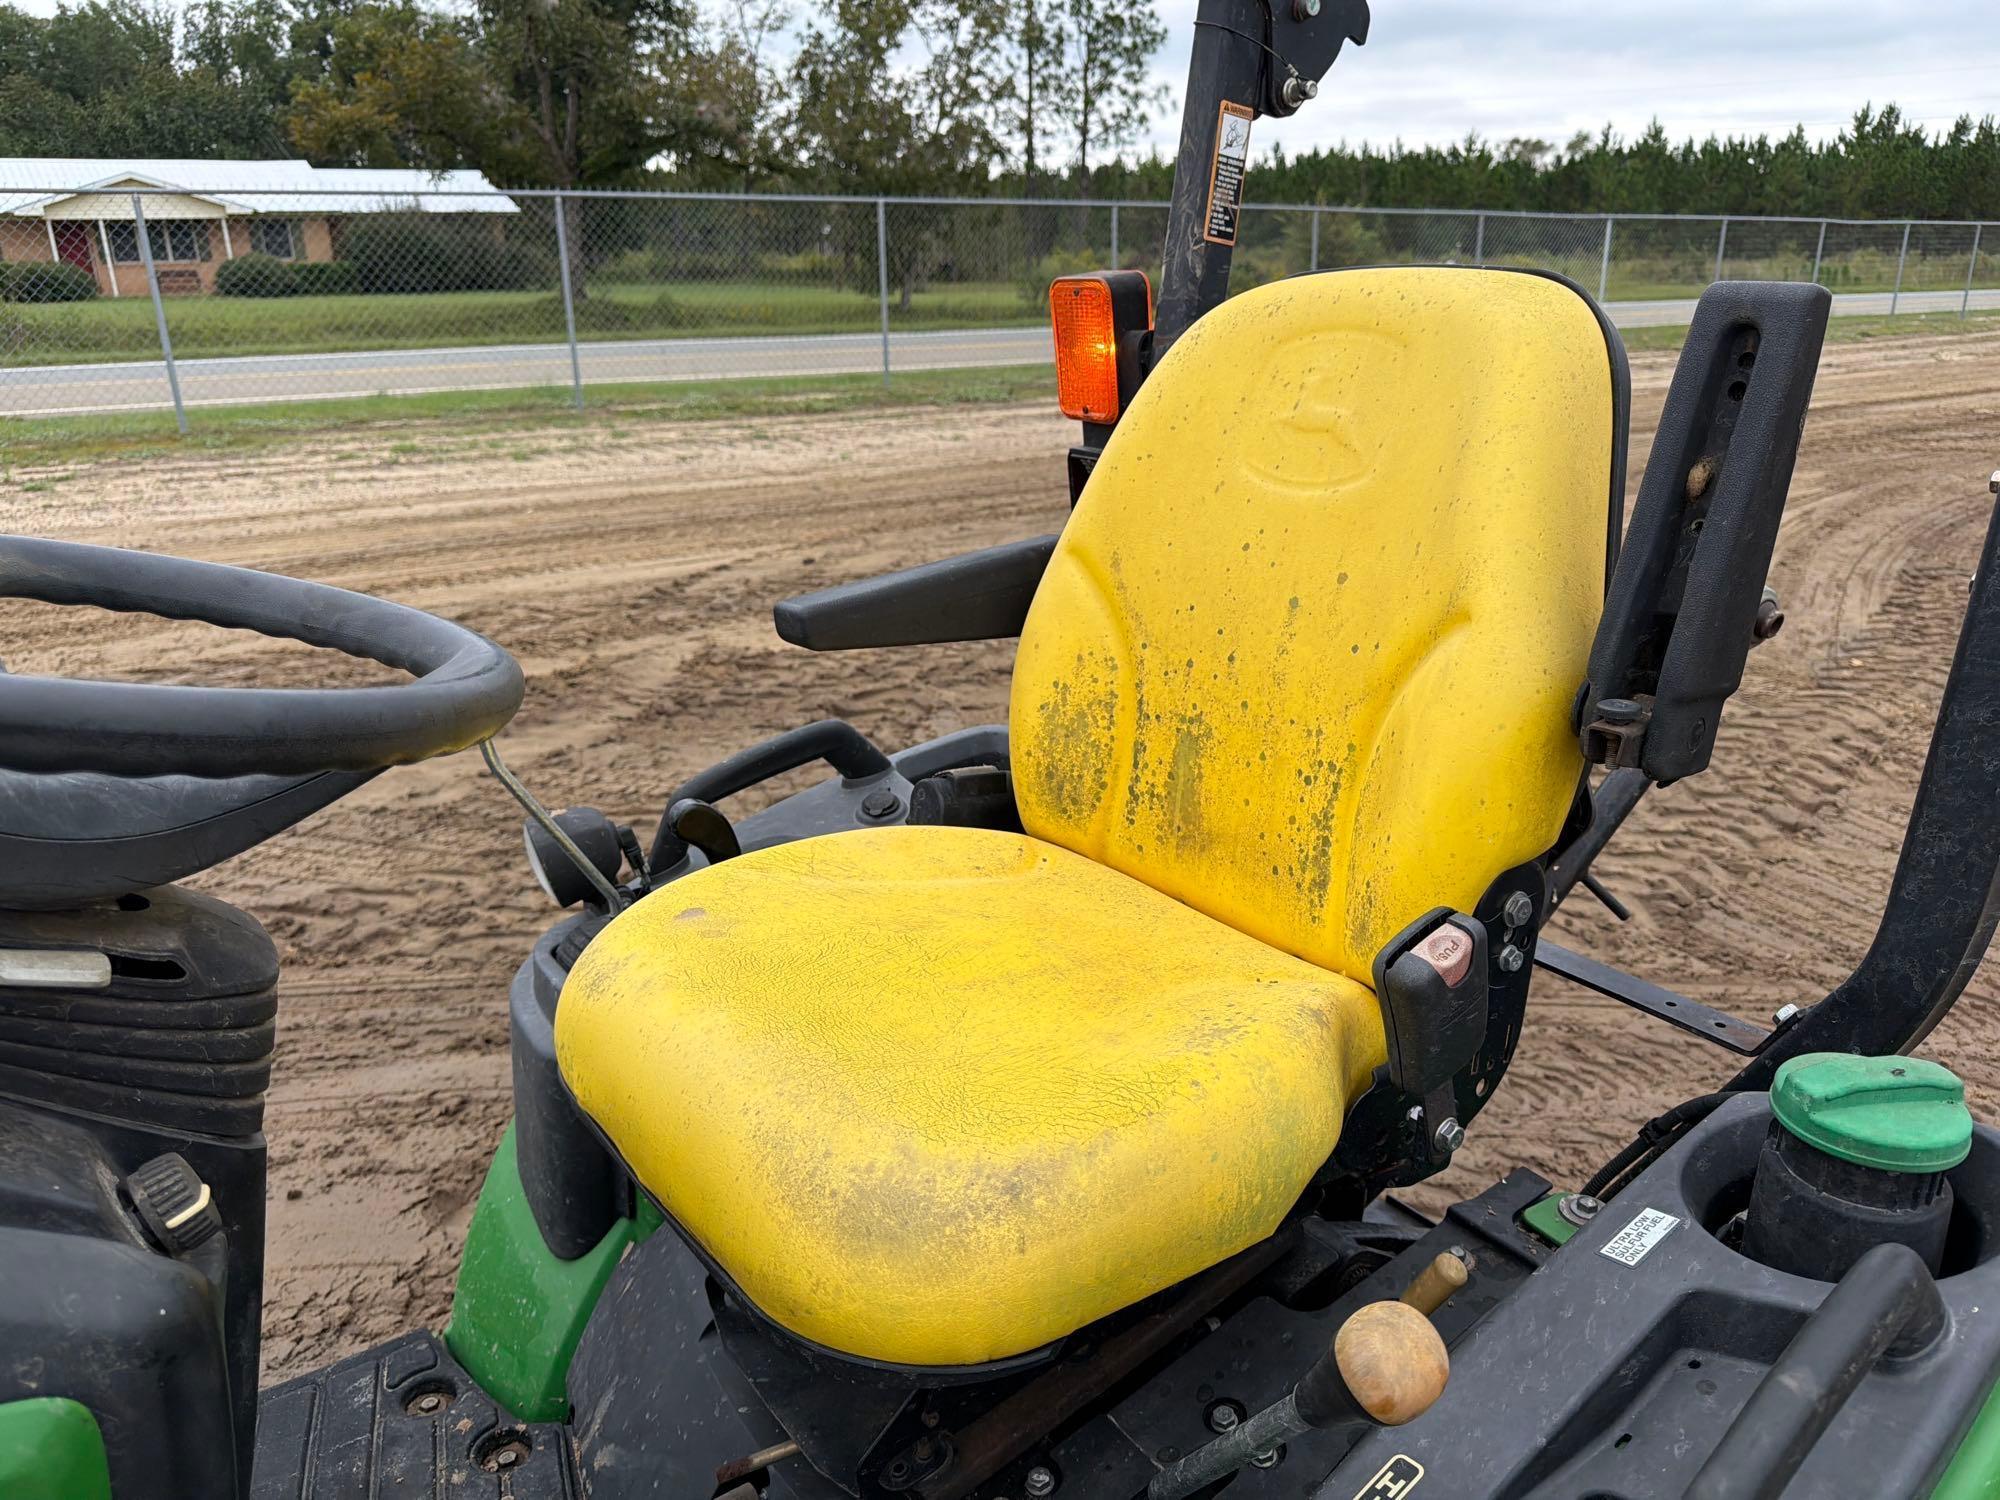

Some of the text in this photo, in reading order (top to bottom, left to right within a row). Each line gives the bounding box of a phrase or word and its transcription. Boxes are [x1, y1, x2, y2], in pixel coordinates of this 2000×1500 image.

[1433, 940, 1460, 961] PUSH
[1605, 1231, 1634, 1254] ULTRA
[1629, 1214, 1650, 1232] LOW
[1615, 1232, 1647, 1258] SULFUR
[1643, 1215, 1666, 1232] FUEL
[1624, 1242, 1648, 1262] ONLY
